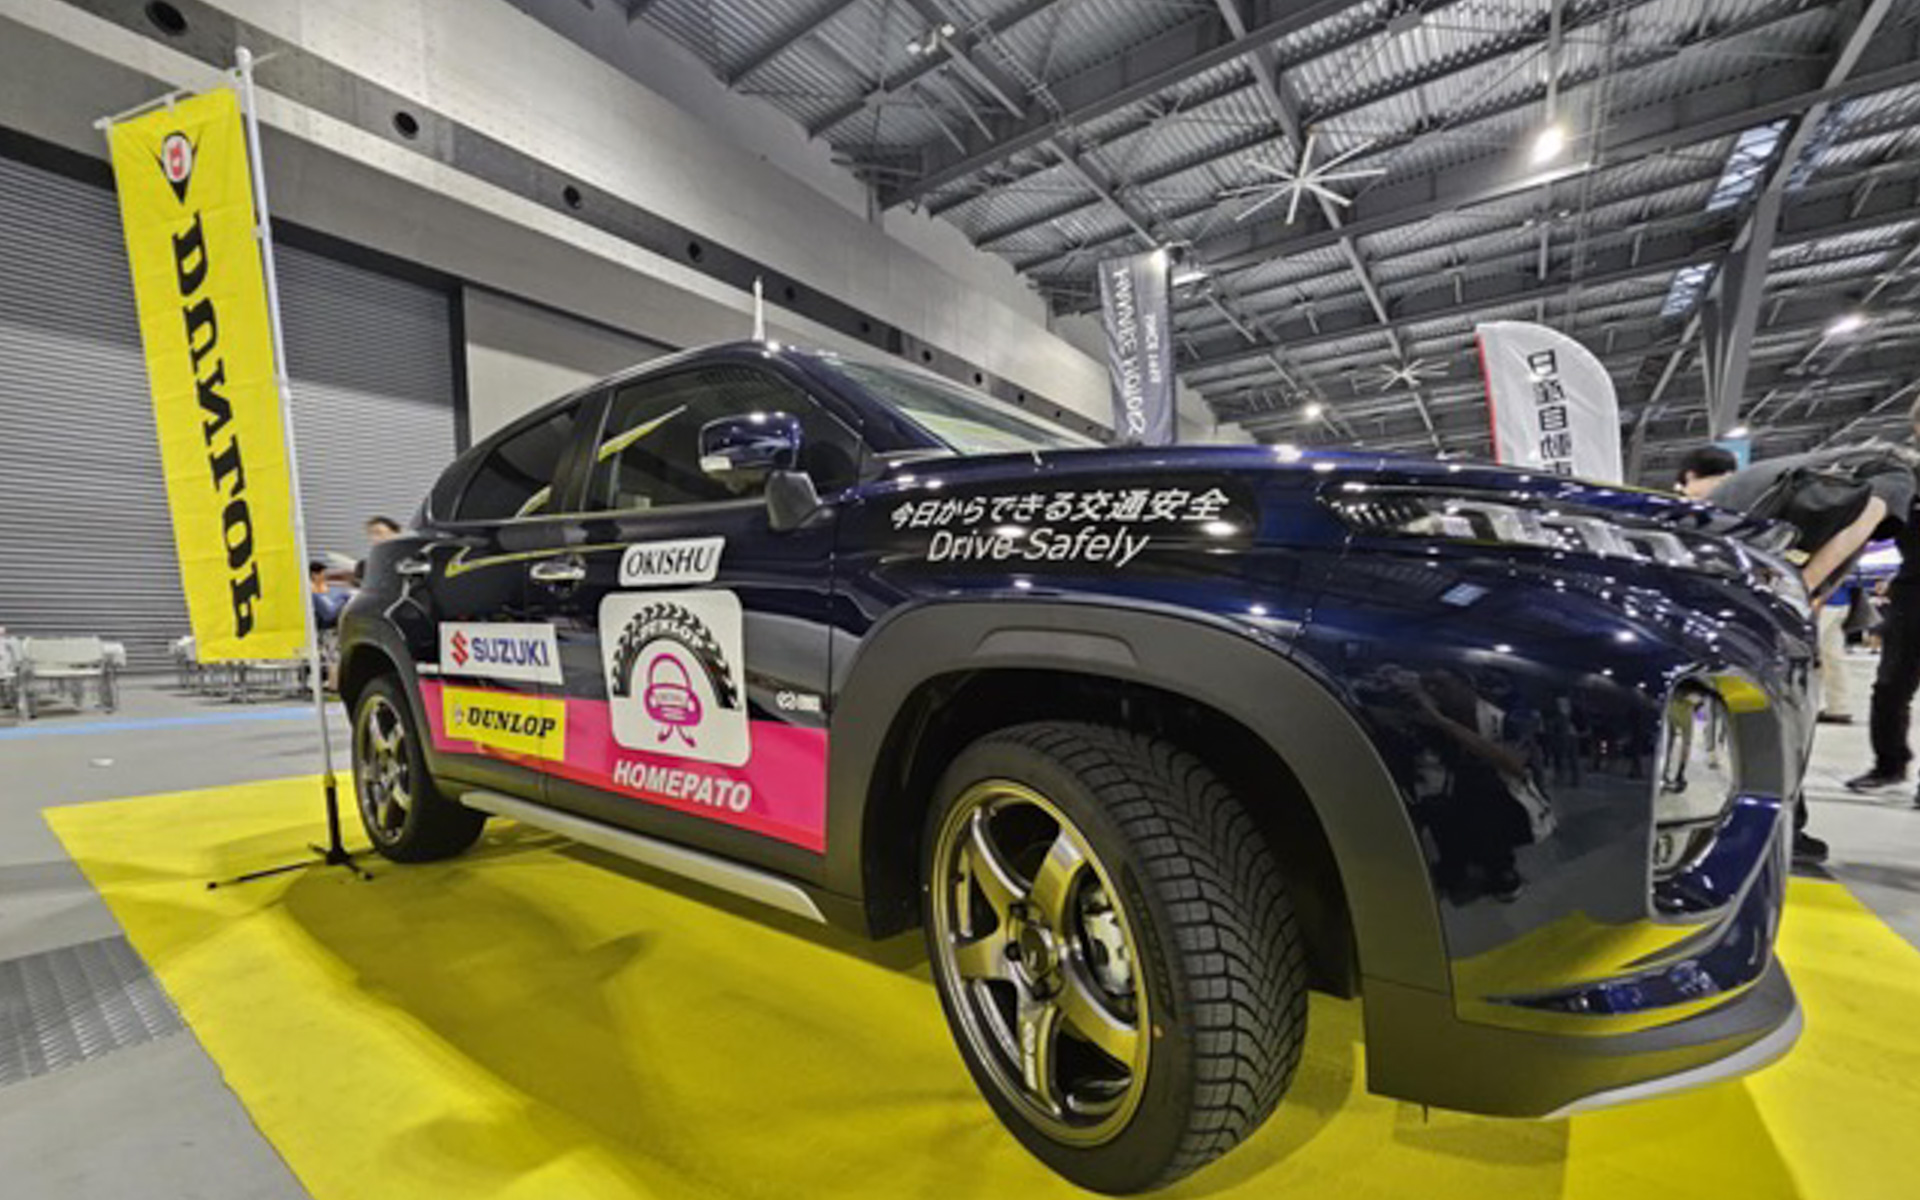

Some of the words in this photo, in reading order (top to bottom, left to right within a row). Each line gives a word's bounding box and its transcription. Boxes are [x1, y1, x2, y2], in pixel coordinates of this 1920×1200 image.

[890, 487, 1231, 529] 今日からできる交通安全
[626, 545, 715, 577] OKISHU
[927, 530, 1014, 562] Drive
[1022, 525, 1151, 568] Safely
[471, 637, 549, 667] SUZUKI
[467, 707, 556, 737] DUNLOP
[613, 760, 752, 812] HOMEPATO
